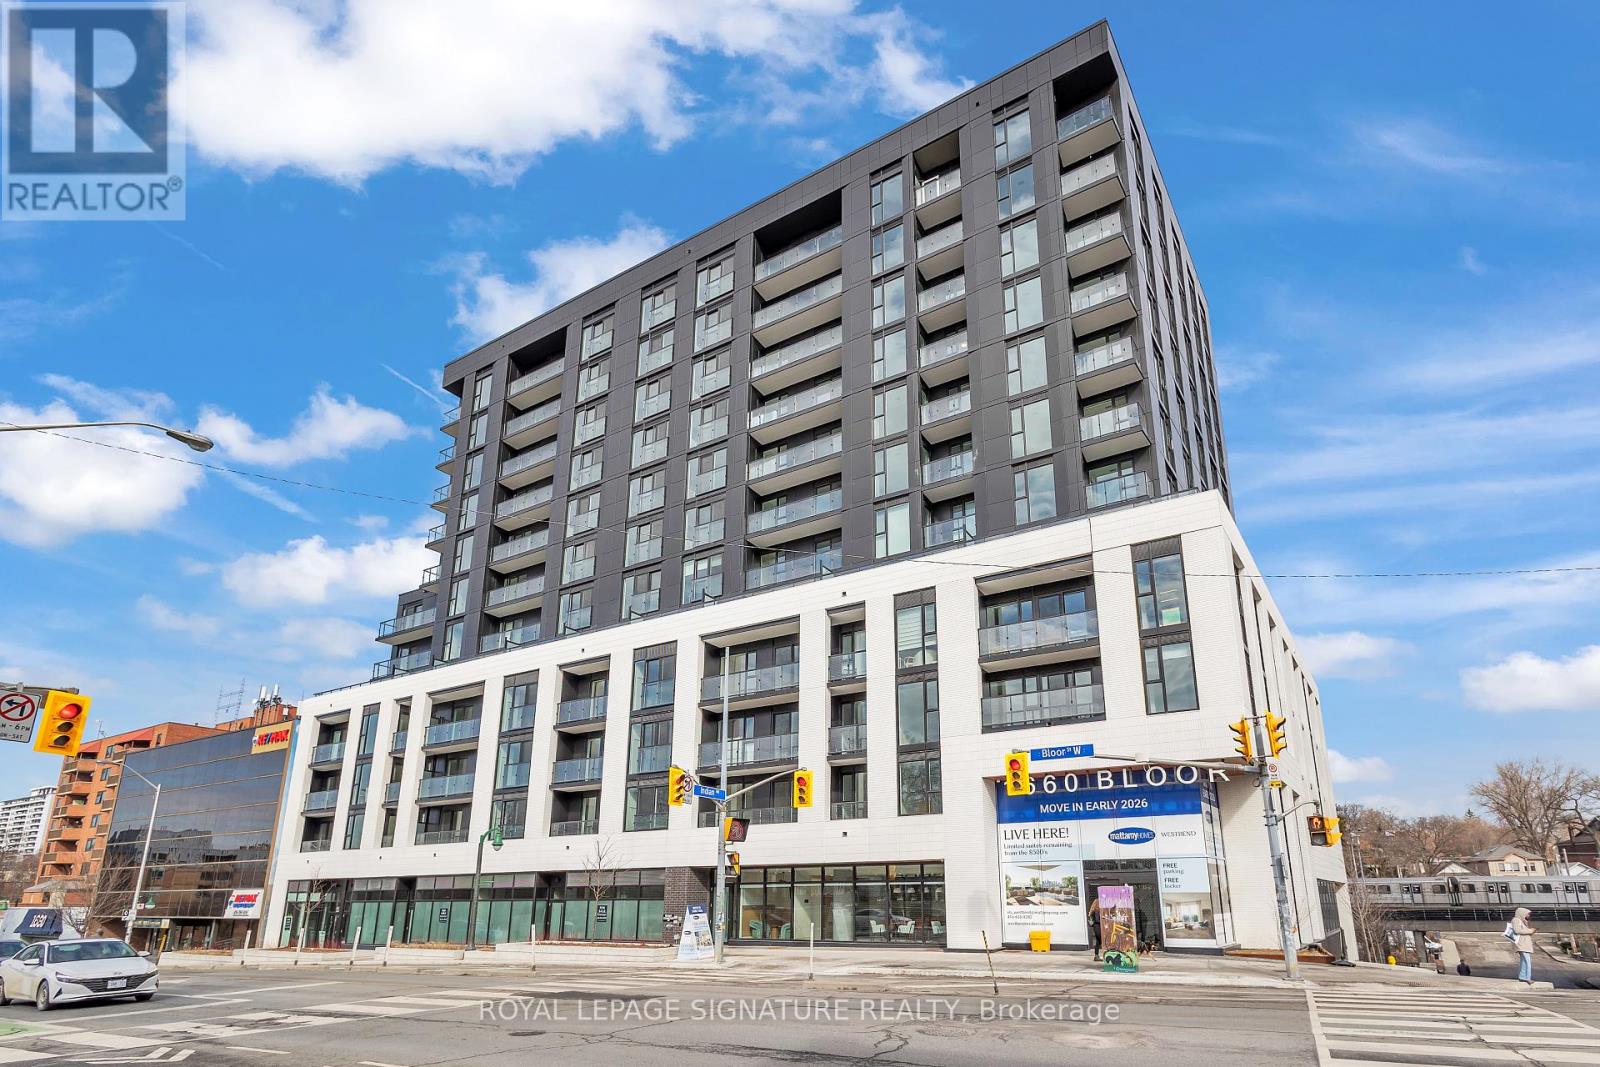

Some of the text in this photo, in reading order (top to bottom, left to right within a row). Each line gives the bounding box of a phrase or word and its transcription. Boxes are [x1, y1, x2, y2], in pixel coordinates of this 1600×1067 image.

[1041, 748, 1066, 758] Bloor
[1073, 745, 1081, 755] W
[1096, 765, 1231, 790] BLOOR
[1040, 798, 1148, 813] MOVE IN EARLY 2026
[1003, 827, 1070, 840] LIVE HERE!
